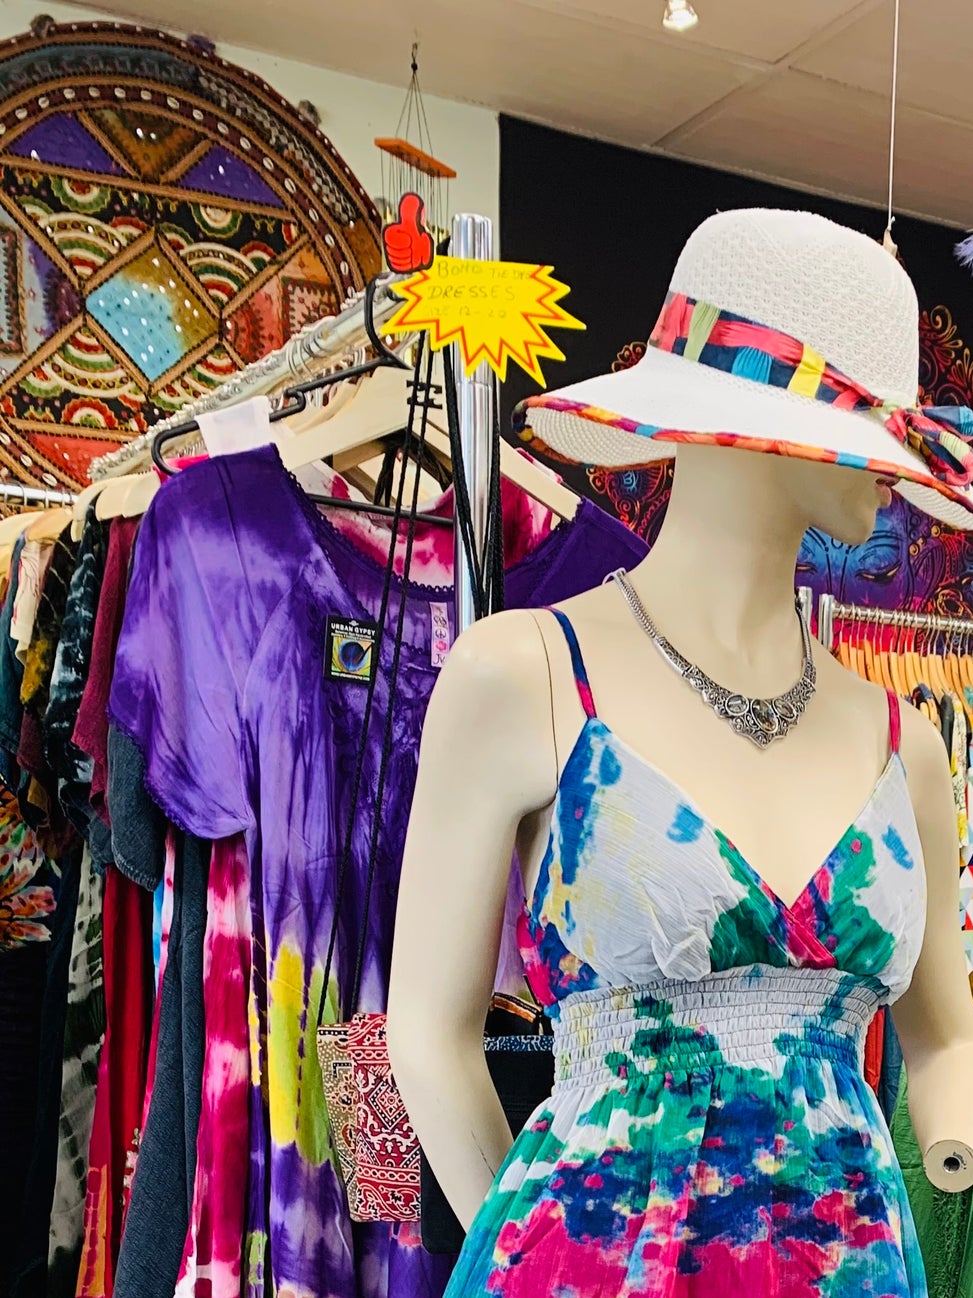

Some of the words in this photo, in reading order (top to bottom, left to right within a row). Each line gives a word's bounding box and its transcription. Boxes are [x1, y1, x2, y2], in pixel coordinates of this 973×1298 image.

[428, 284, 516, 300] DRESSES
[330, 622, 354, 633] URBAN
[354, 626, 376, 637] GYPSY
